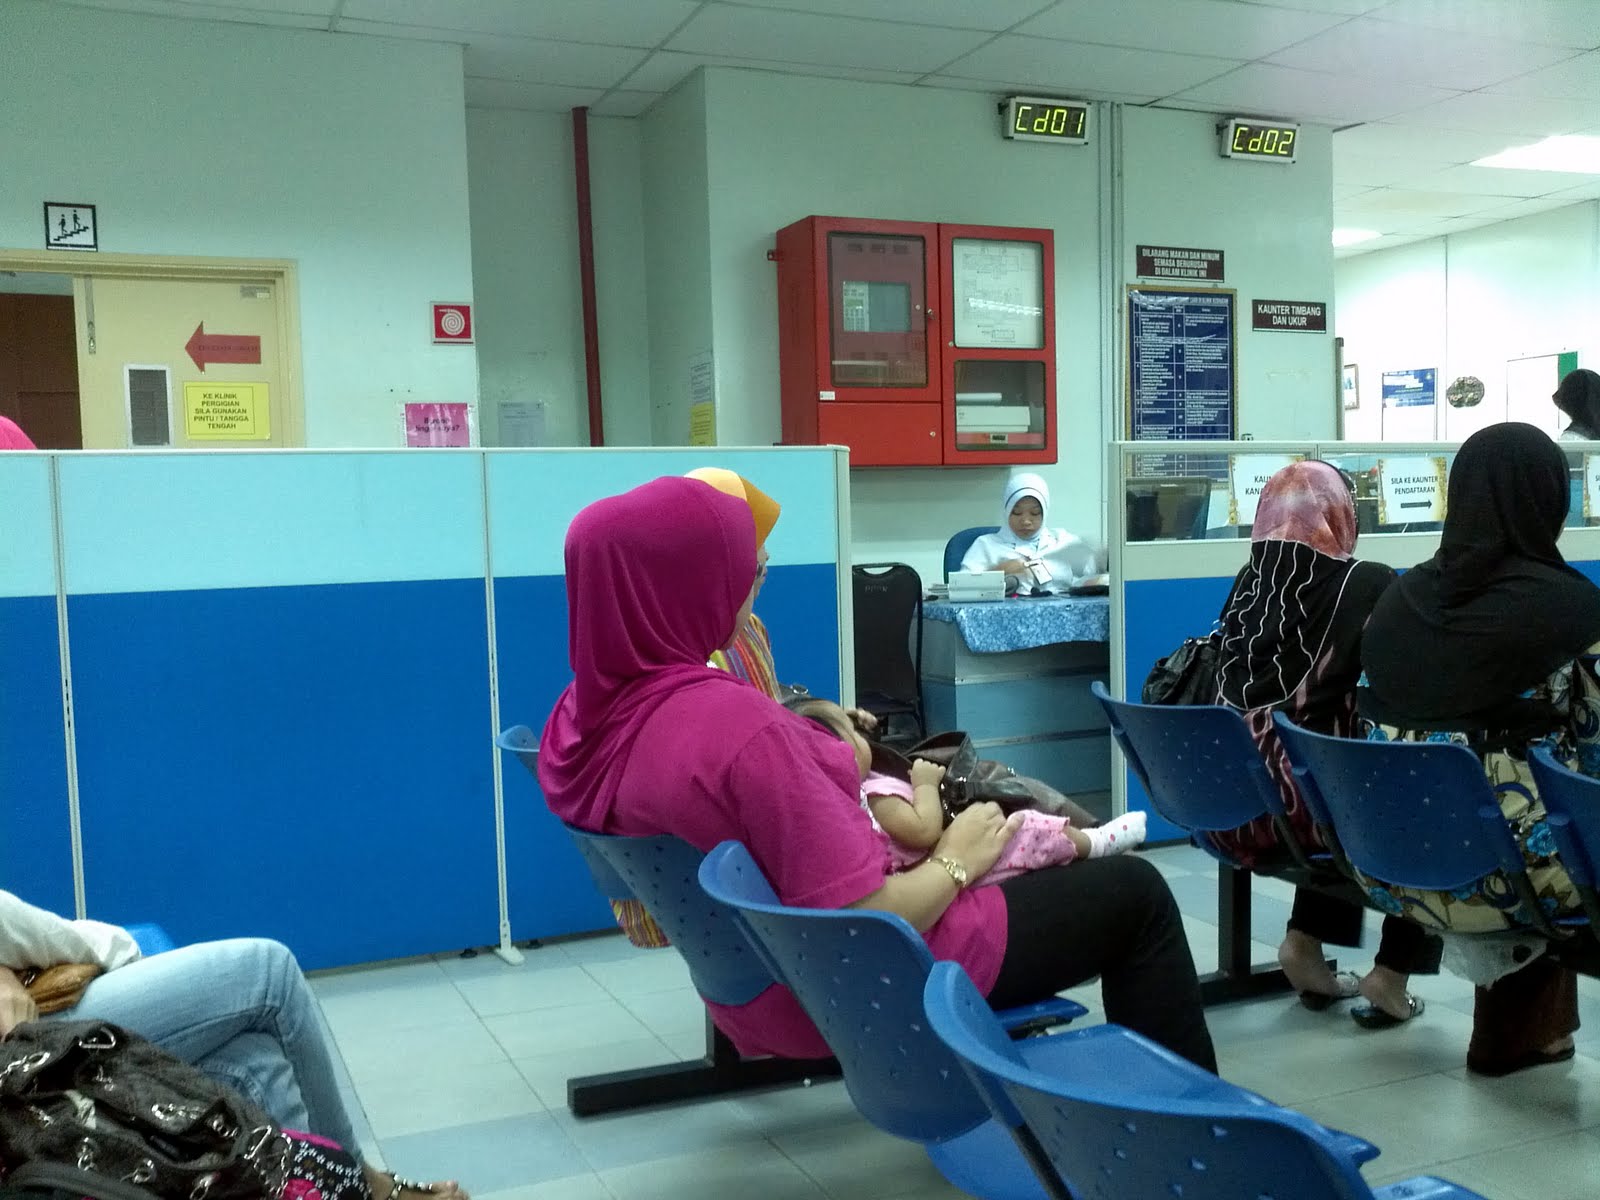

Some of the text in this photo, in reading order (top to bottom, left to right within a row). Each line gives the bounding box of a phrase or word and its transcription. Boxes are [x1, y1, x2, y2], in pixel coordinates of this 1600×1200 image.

[1142, 248, 1220, 261] DILARANG MAKAN DAN MINUM
[1153, 258, 1176, 267] SEMASA
[1162, 267, 1180, 276] DALAM
[1181, 268, 1198, 277] KLINIK
[1199, 269, 1207, 278] INI
[1257, 304, 1321, 316] KAUNTER TIMBANG
[1272, 315, 1307, 326] DAN UKUR
[1391, 475, 1439, 485] SILA KE KAUNTER
[1394, 486, 1436, 495] PENDAFTARAN
